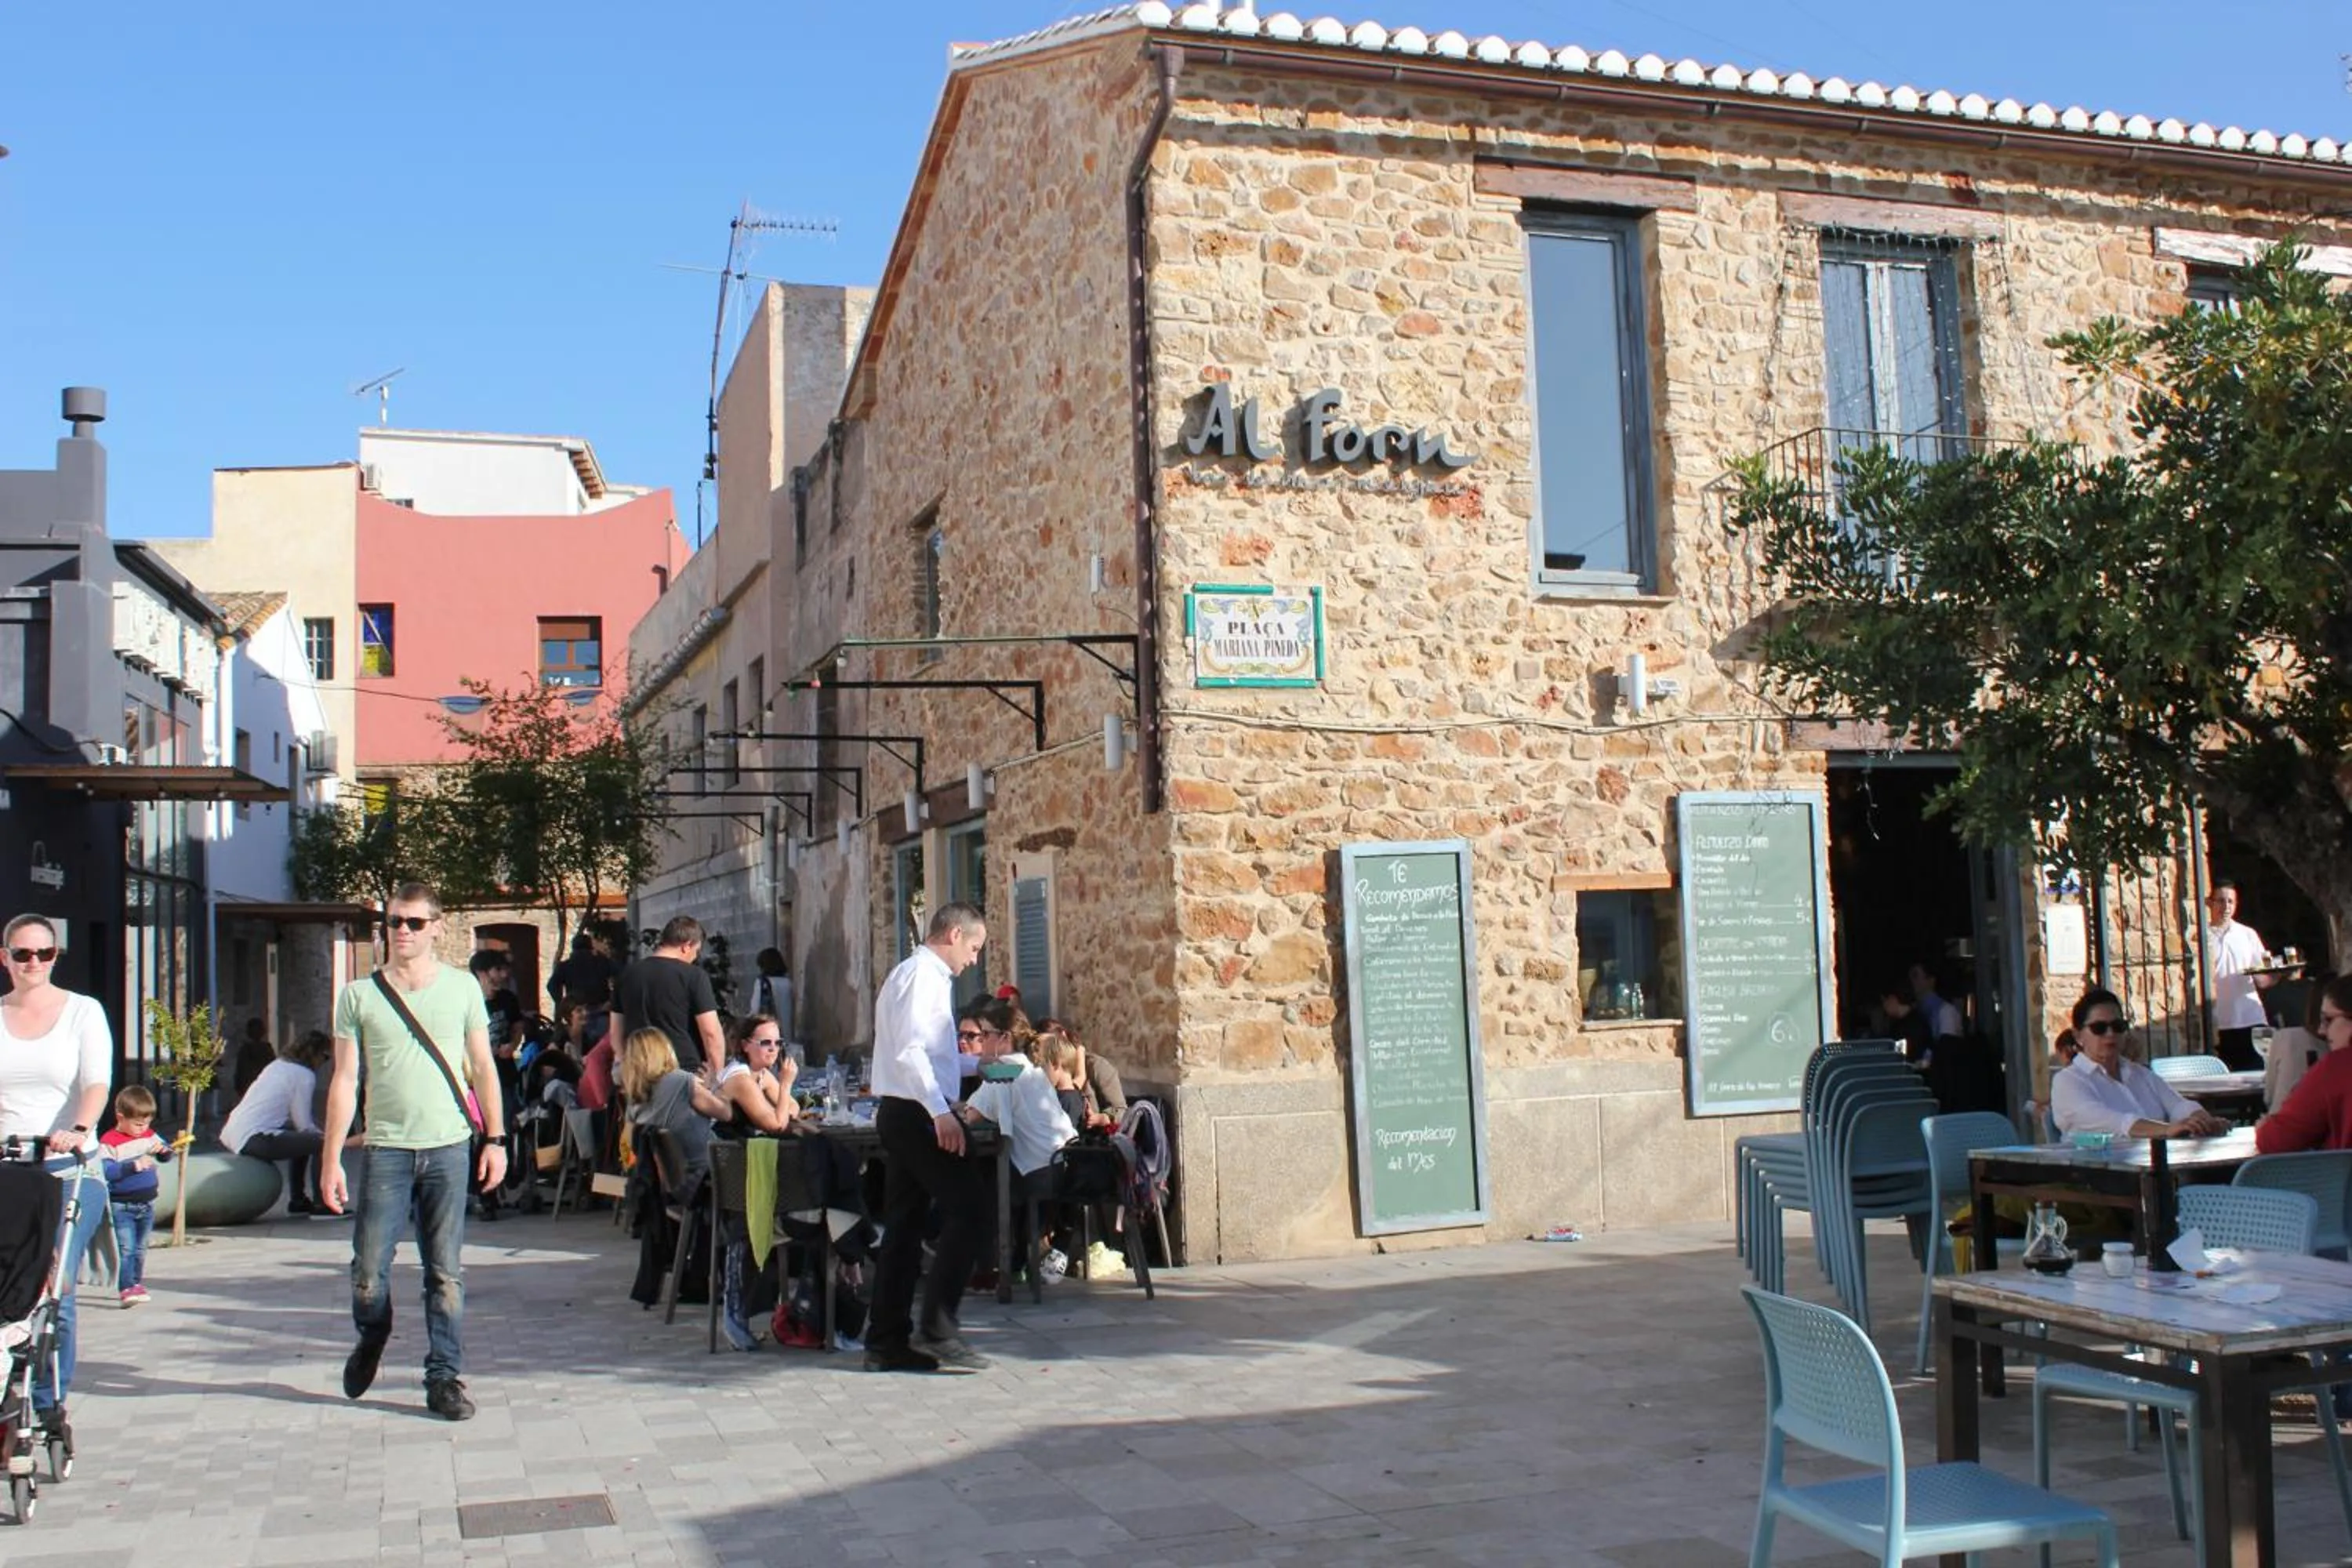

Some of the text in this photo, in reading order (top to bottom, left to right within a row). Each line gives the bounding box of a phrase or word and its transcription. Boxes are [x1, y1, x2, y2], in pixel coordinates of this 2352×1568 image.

[1187, 382, 1479, 467] Al forn
[1227, 622, 1284, 637] PLAÇA
[1214, 639, 1299, 657] MARIANA PINEDA
[1388, 859, 1408, 884] TE
